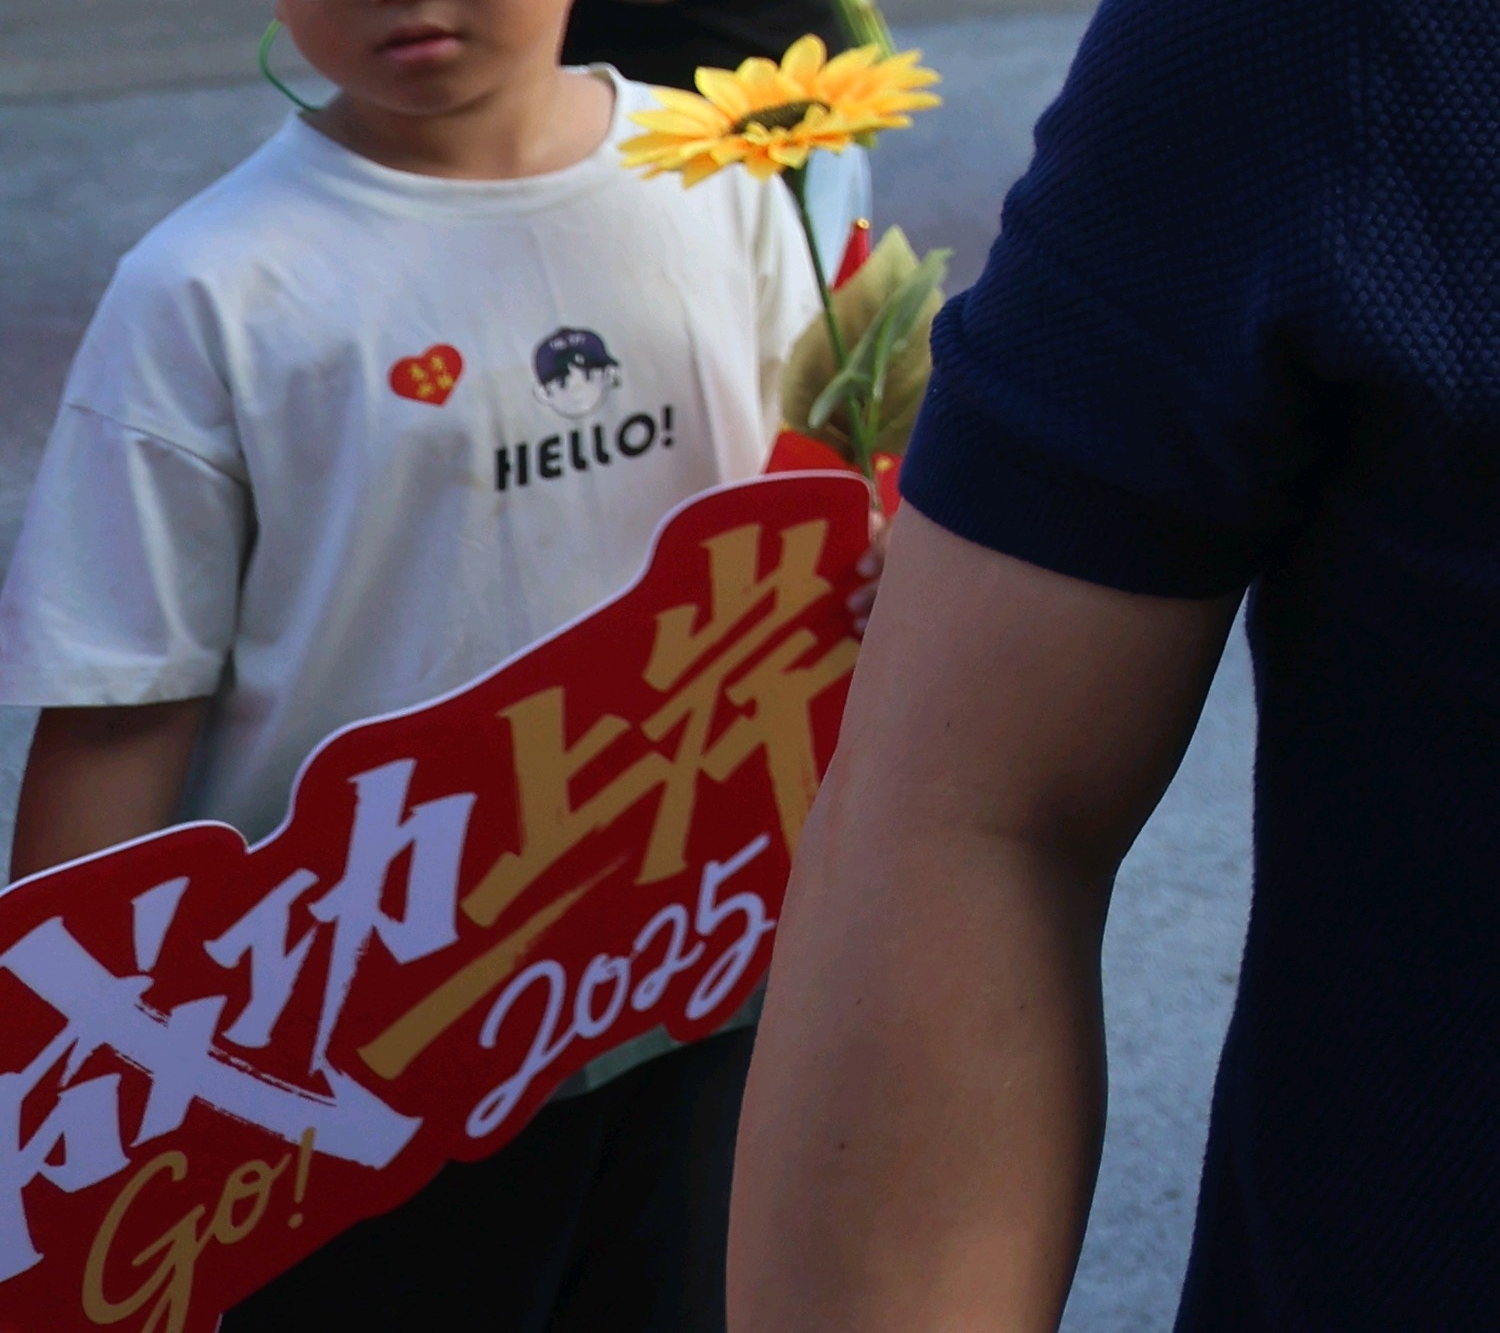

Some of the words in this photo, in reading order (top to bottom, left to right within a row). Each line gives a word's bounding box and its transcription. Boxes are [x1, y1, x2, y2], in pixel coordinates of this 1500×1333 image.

[495, 404, 676, 492] HELLO!
[467, 835, 776, 1137] 2025
[82, 1127, 316, 1333] Go!
